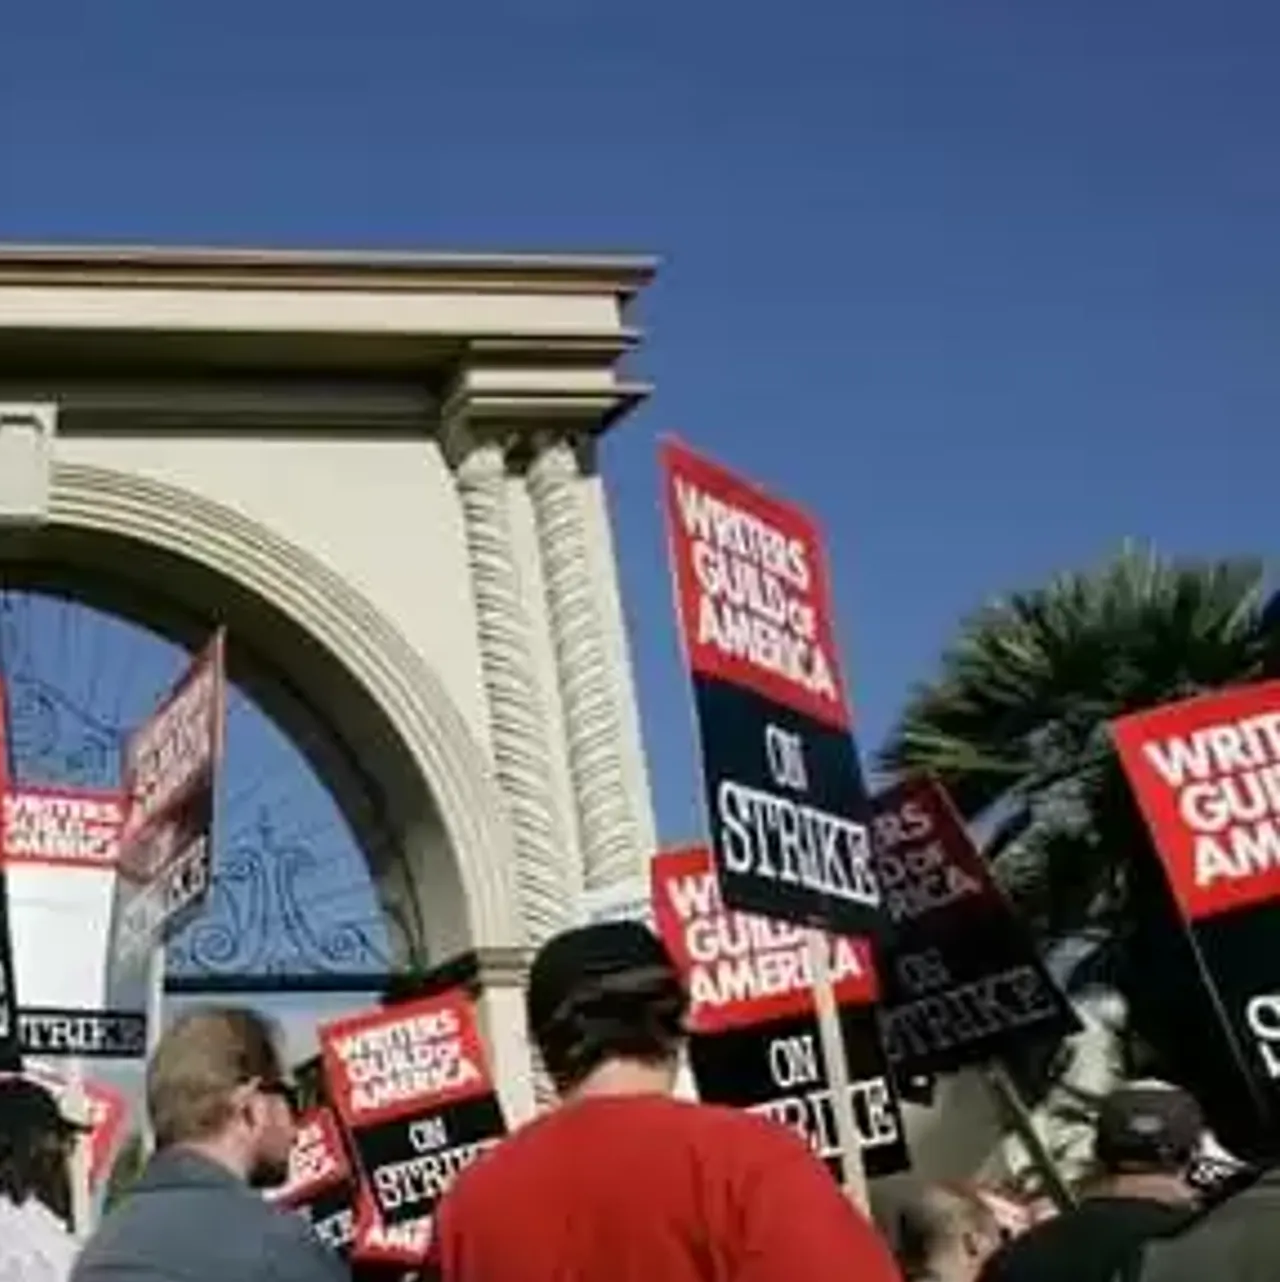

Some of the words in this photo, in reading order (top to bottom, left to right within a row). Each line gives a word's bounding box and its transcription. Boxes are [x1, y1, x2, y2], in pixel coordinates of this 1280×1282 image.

[673, 474, 811, 592] WRITERS
[691, 540, 786, 626] GUILD
[787, 602, 816, 644] OF
[699, 594, 837, 702] AMERICA
[765, 723, 809, 791] ON
[1142, 711, 1280, 787] WRIT
[1180, 763, 1280, 833] GUI
[718, 779, 880, 908] STRIKE
[689, 936, 861, 1007] AMERIA
[18, 1015, 143, 1051] TRIKE
[1246, 995, 1280, 1042] O
[770, 1034, 818, 1088] ON
[408, 1116, 449, 1152] ON
[372, 1143, 482, 1210] STRI
